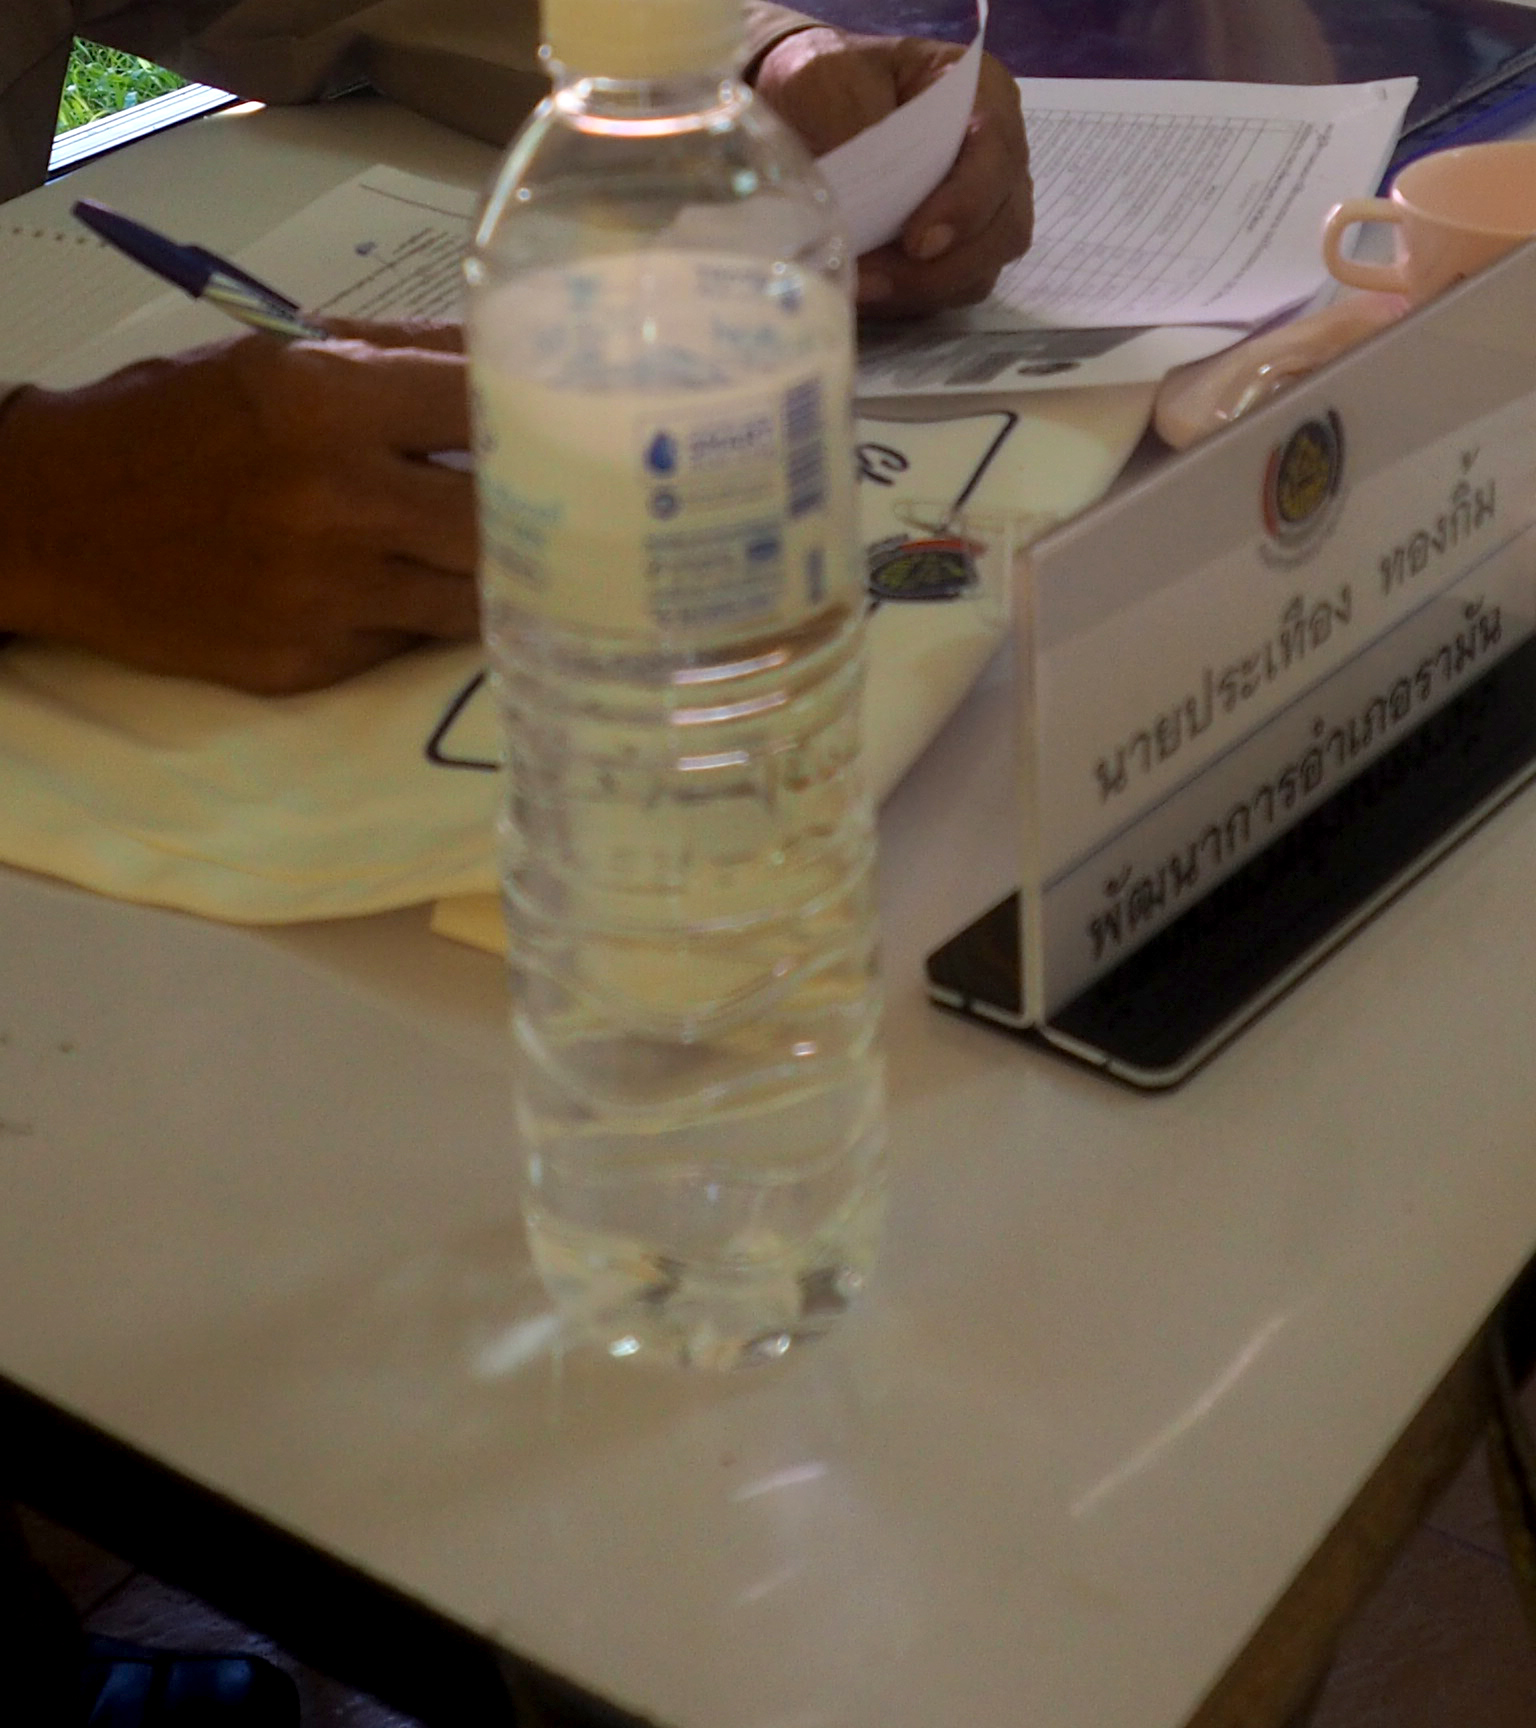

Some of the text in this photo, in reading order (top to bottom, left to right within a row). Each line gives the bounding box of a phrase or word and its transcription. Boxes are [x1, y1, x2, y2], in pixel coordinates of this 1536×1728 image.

[1086, 595, 1503, 960] พัฒนาการอำเภอรามัน
